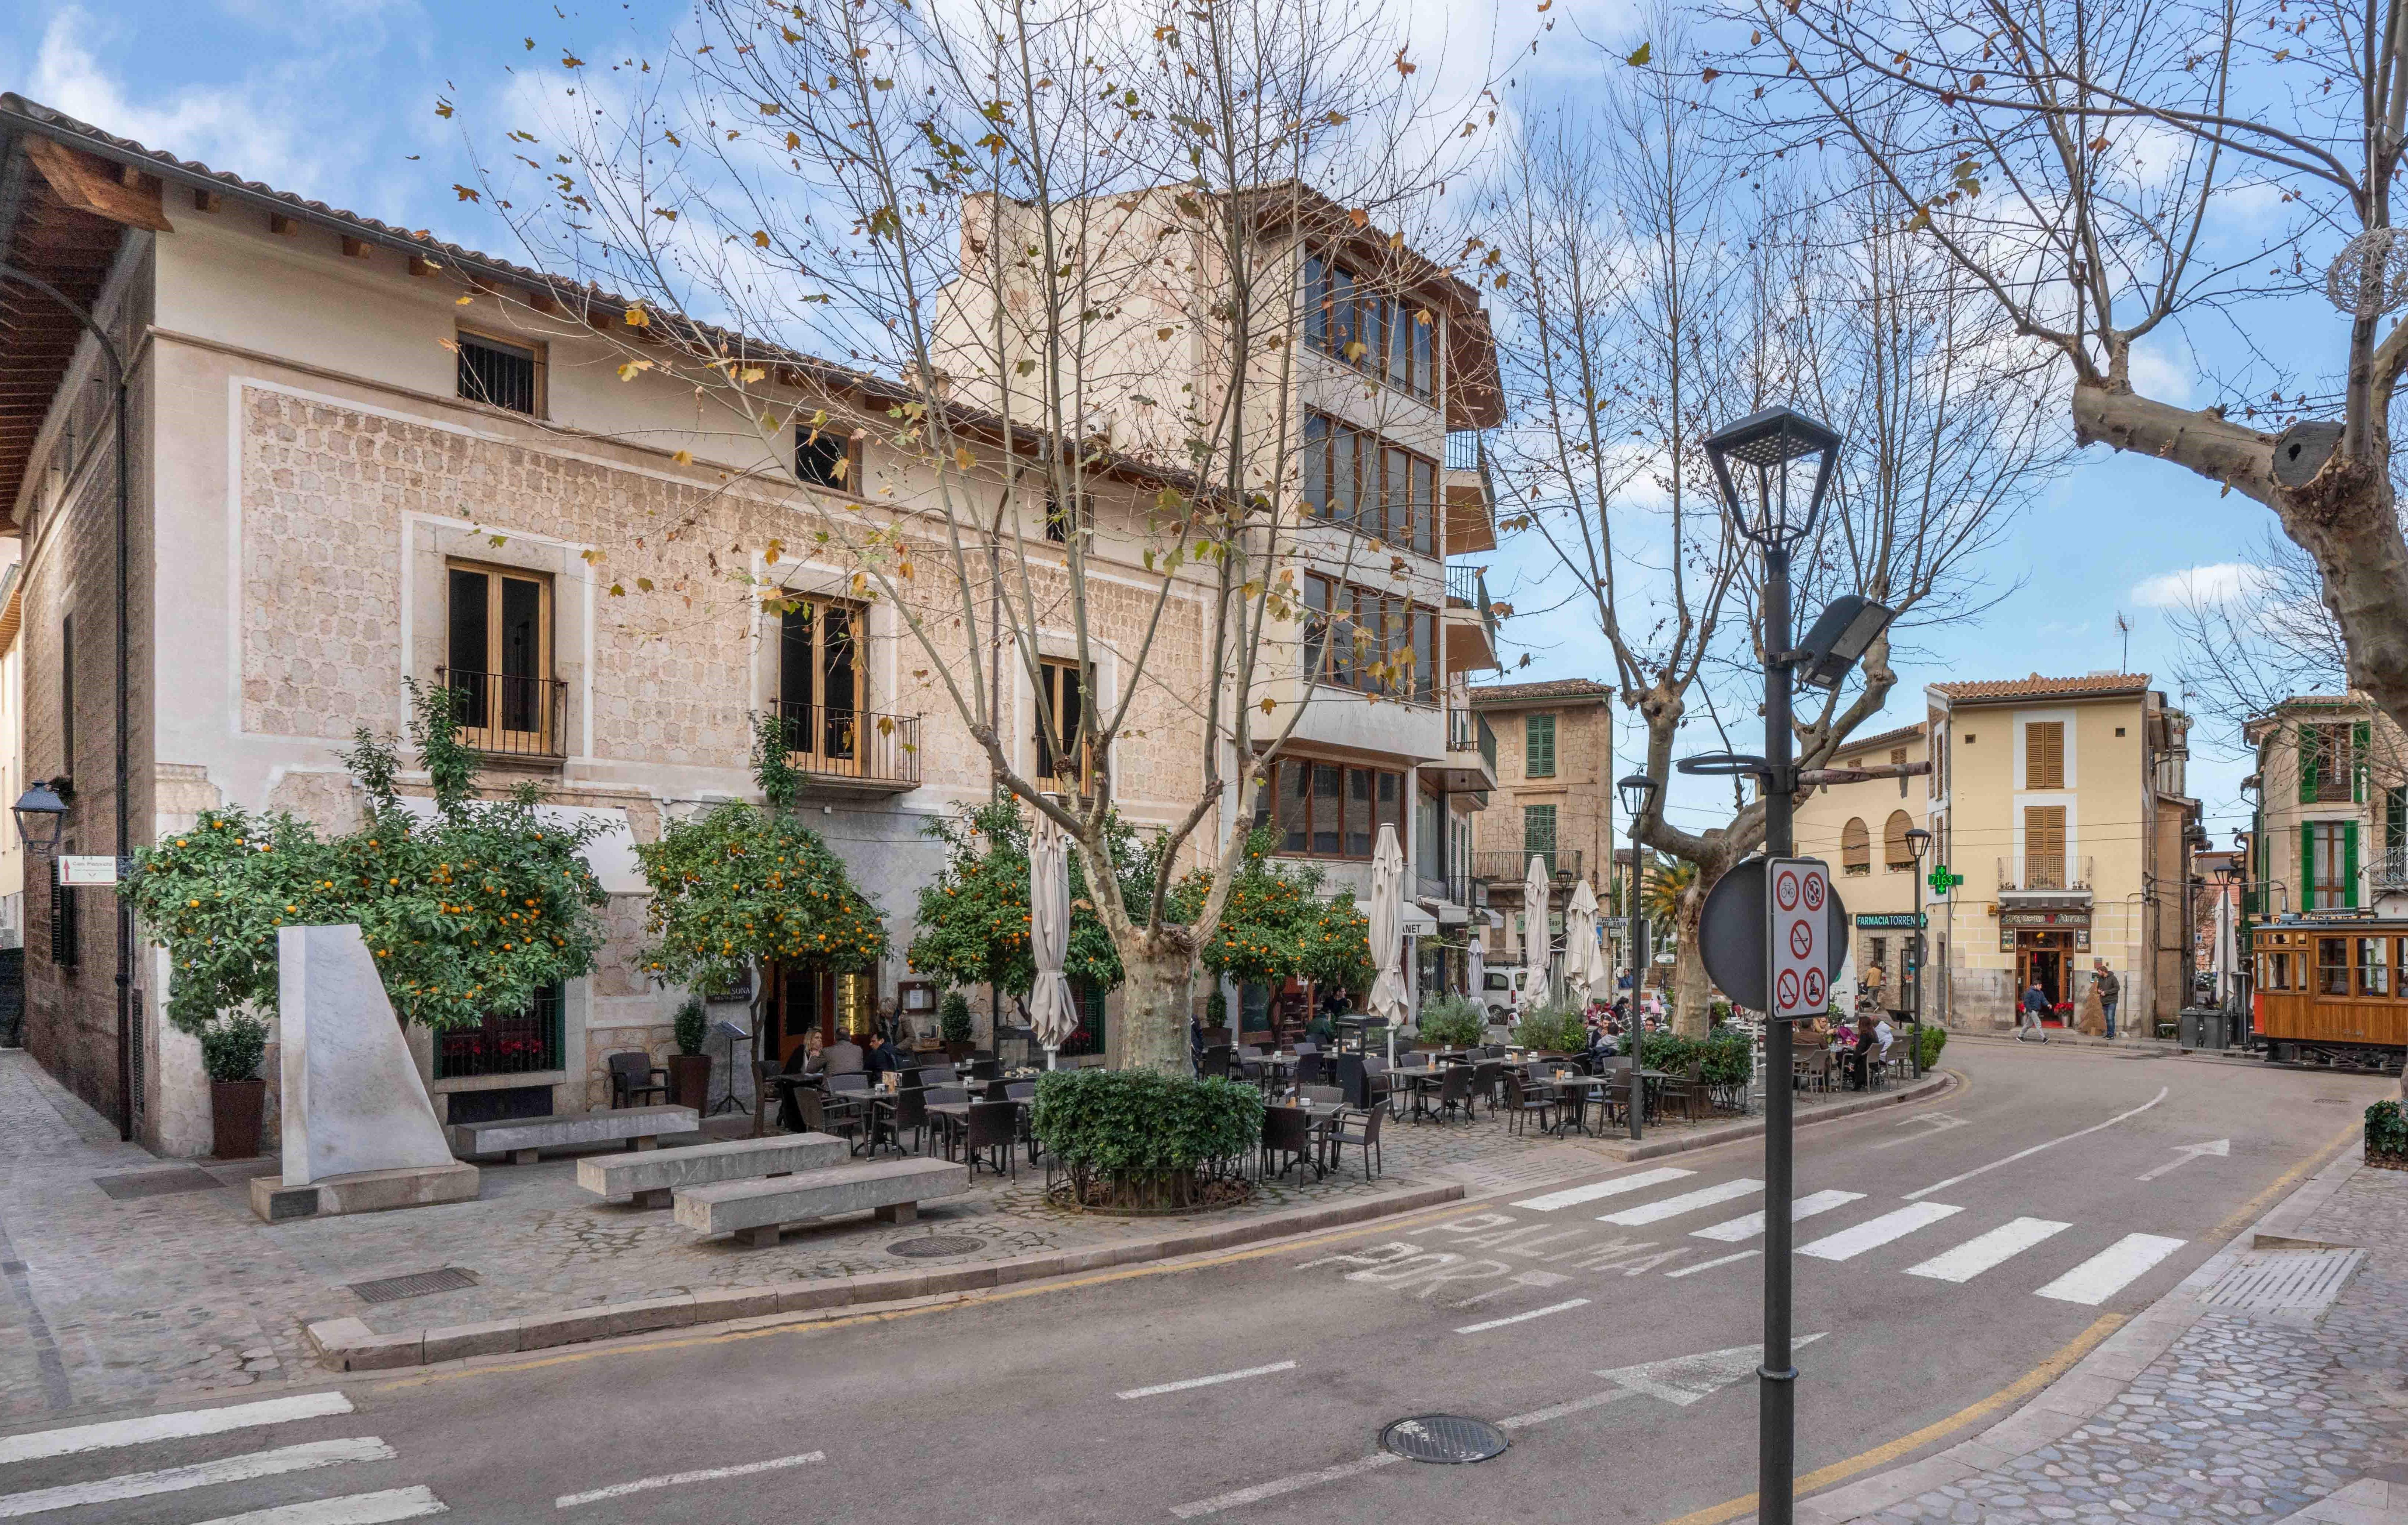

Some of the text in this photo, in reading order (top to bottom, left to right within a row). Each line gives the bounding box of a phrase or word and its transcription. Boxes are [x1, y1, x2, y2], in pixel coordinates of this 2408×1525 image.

[1857, 916, 1915, 925] FARMACIA TORREN
[1405, 1213, 1693, 1277] PALMA
